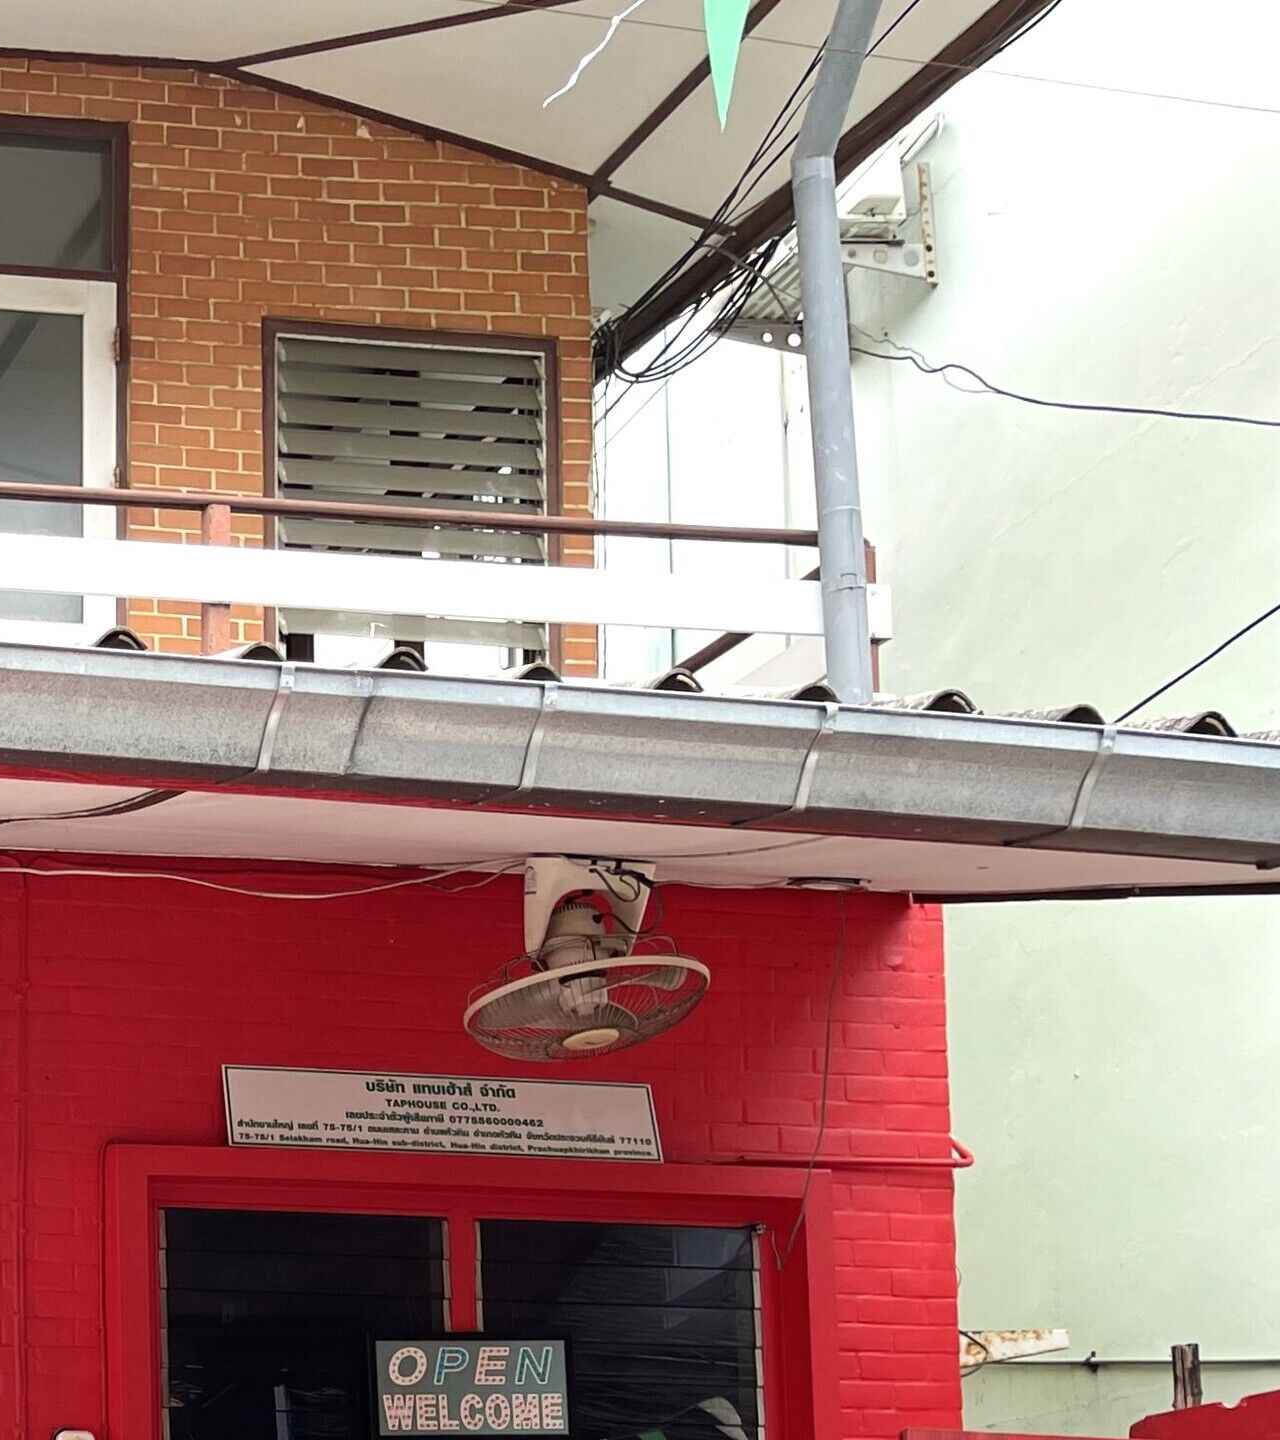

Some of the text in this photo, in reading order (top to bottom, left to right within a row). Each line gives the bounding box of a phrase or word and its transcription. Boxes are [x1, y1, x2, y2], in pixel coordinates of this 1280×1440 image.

[366, 1078, 405, 1093] บริษัท
[480, 1083, 517, 1099] จำกัด
[386, 1098, 447, 1110] TAPHOUSE
[388, 1345, 553, 1387] OPEN
[382, 1392, 565, 1432] WELCOME
